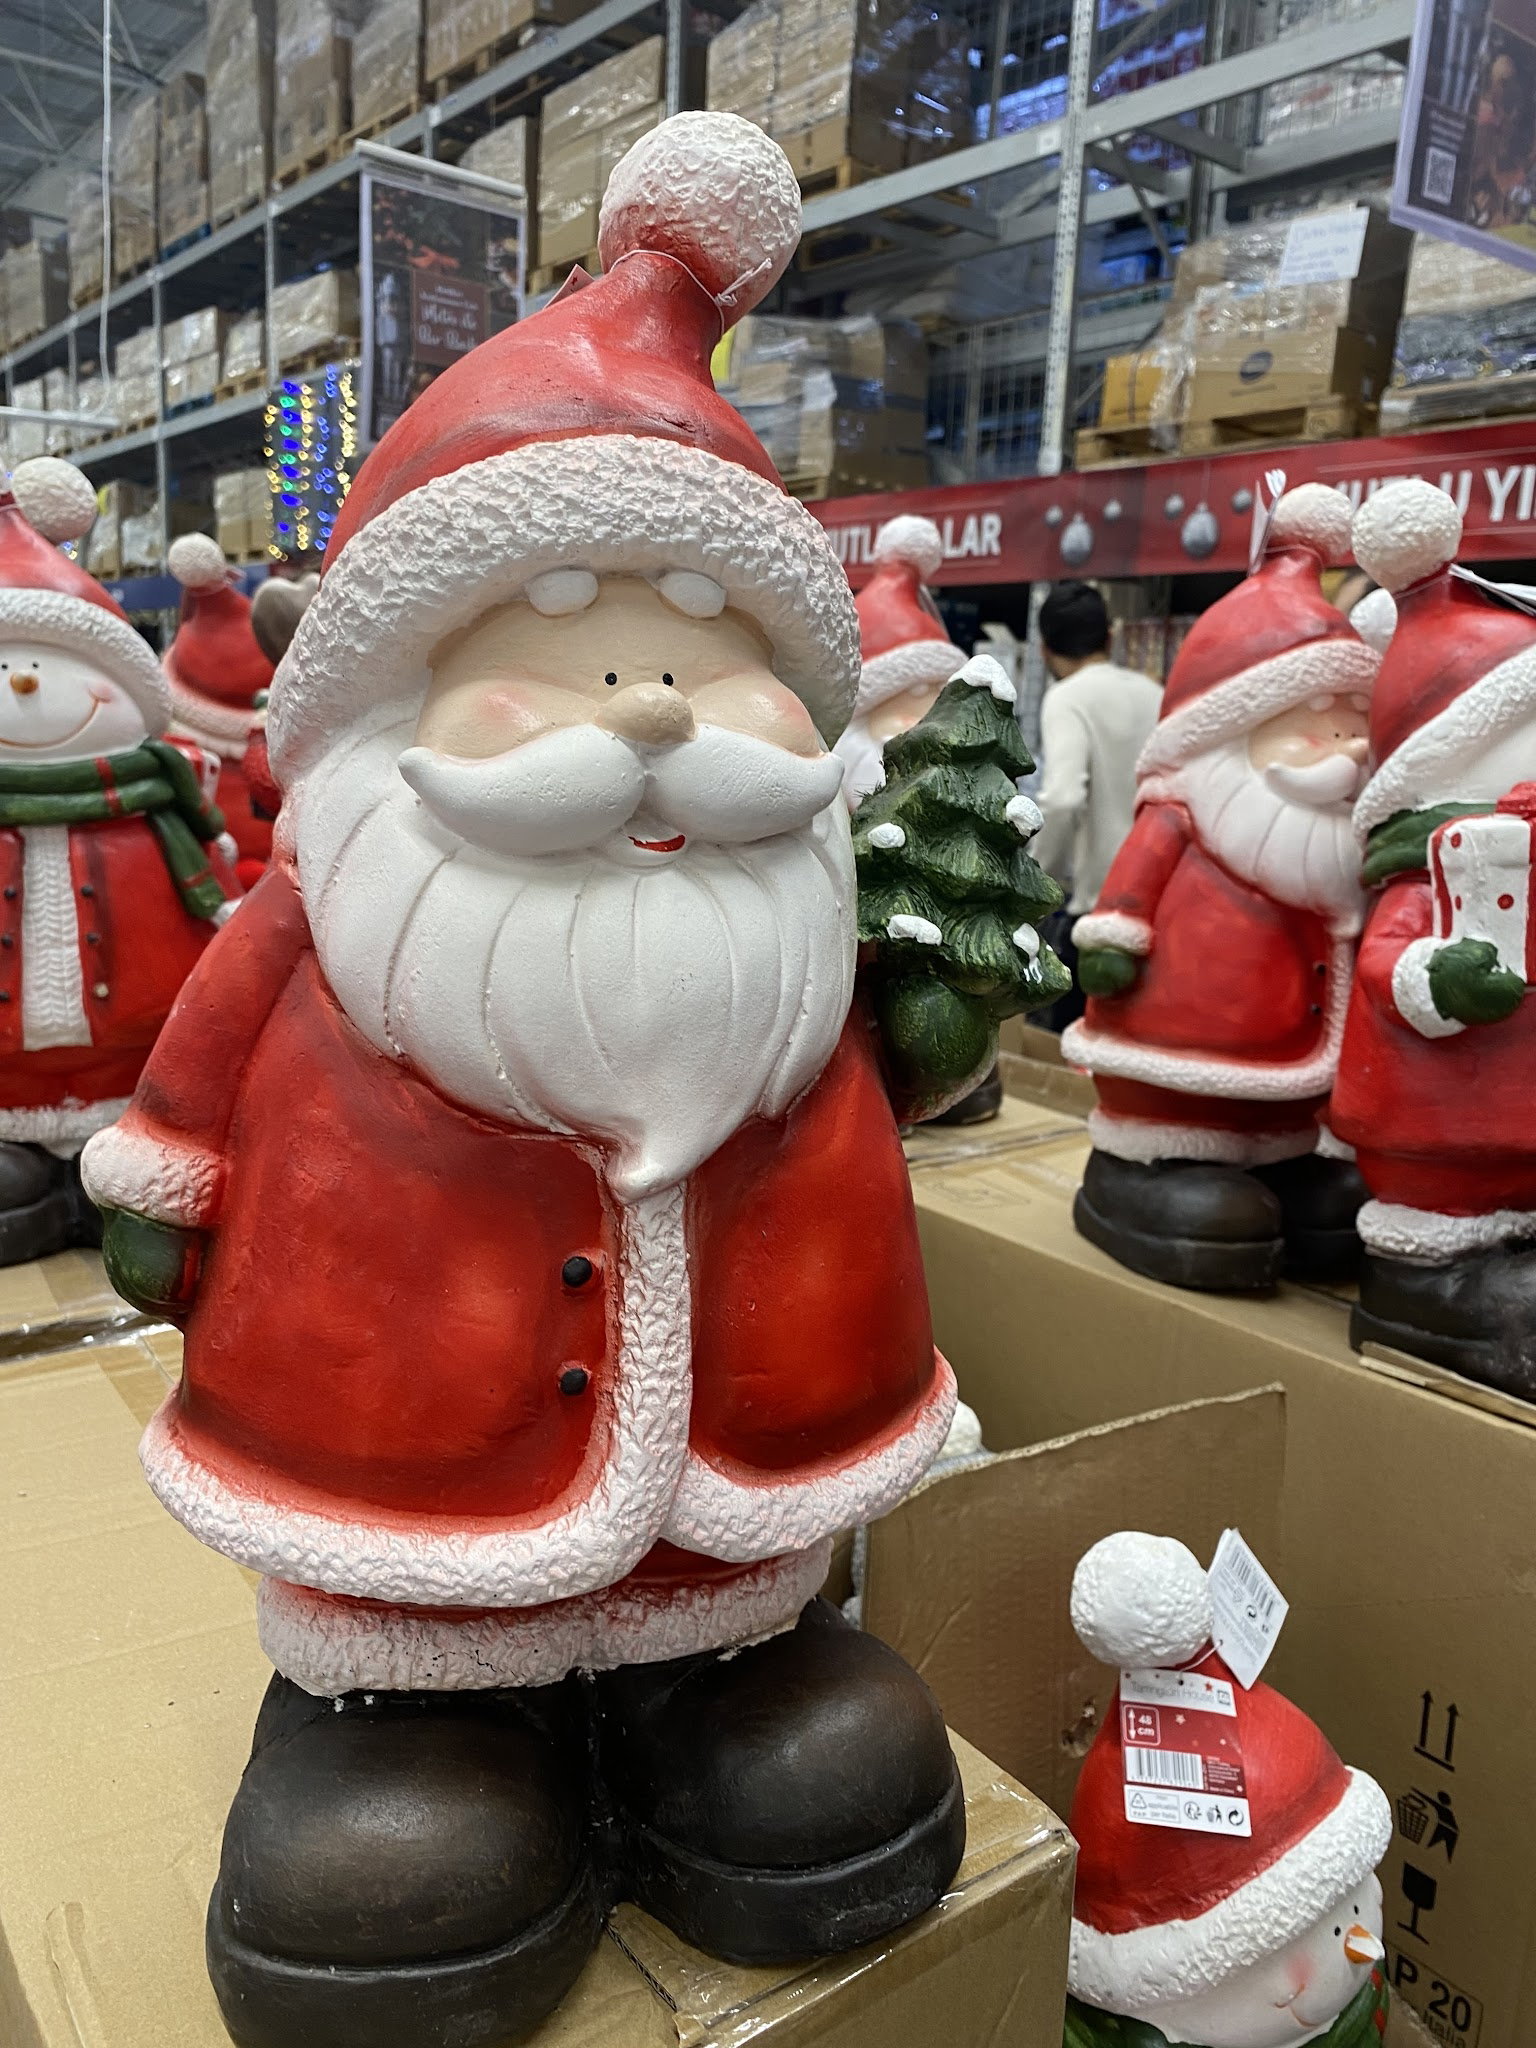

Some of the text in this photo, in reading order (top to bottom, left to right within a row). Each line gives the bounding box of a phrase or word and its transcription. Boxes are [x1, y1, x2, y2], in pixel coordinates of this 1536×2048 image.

[1484, 464, 1536, 522] YI
[829, 513, 1002, 564] UTL LAR
[1136, 1727, 1155, 1737] cm
[1388, 1954, 1472, 2032] P 20
